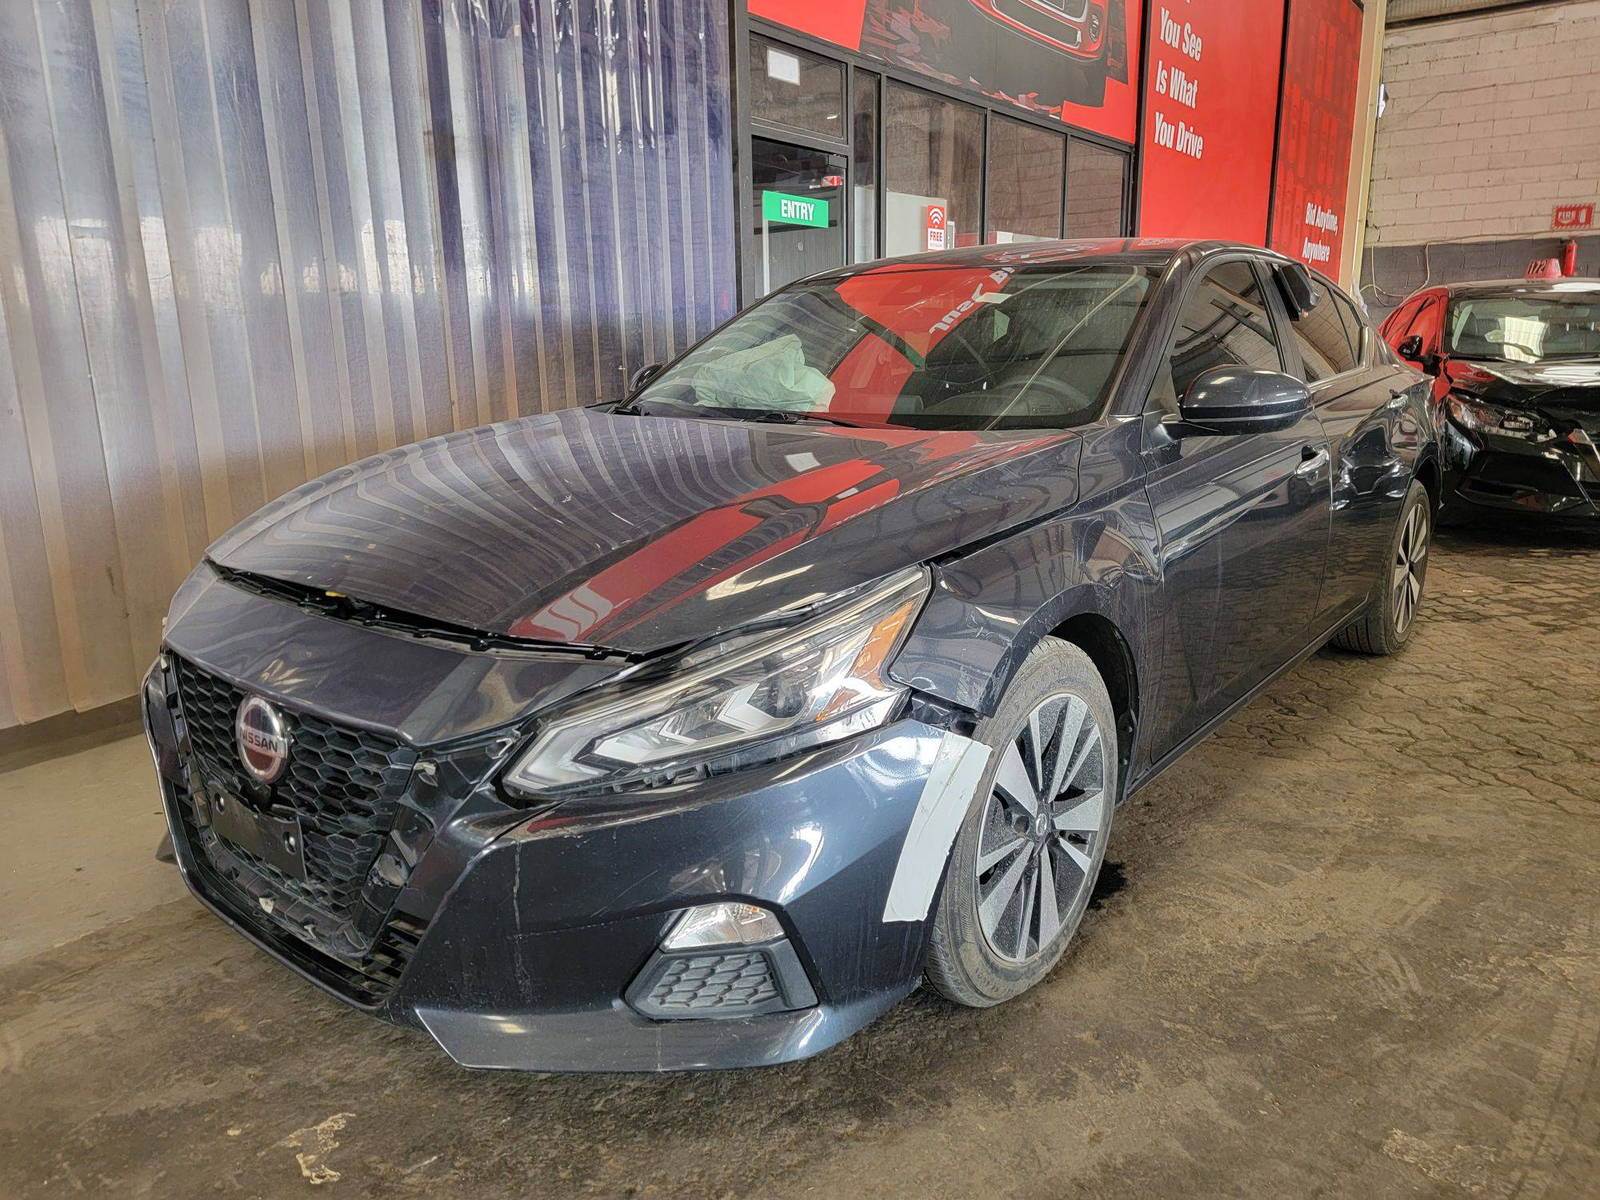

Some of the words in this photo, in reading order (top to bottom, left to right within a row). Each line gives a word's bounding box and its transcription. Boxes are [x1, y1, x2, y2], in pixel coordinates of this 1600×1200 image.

[1160, 7, 1181, 49] You
[1182, 22, 1202, 62] See
[1155, 60, 1168, 95] Is
[1169, 66, 1198, 109] What
[1154, 111, 1175, 149] You
[1175, 121, 1204, 160] Drive
[781, 199, 815, 221] ENTRY
[930, 231, 943, 242] FREE
[1302, 237, 1330, 263] Anywhere
[240, 729, 278, 753] NISSAN
